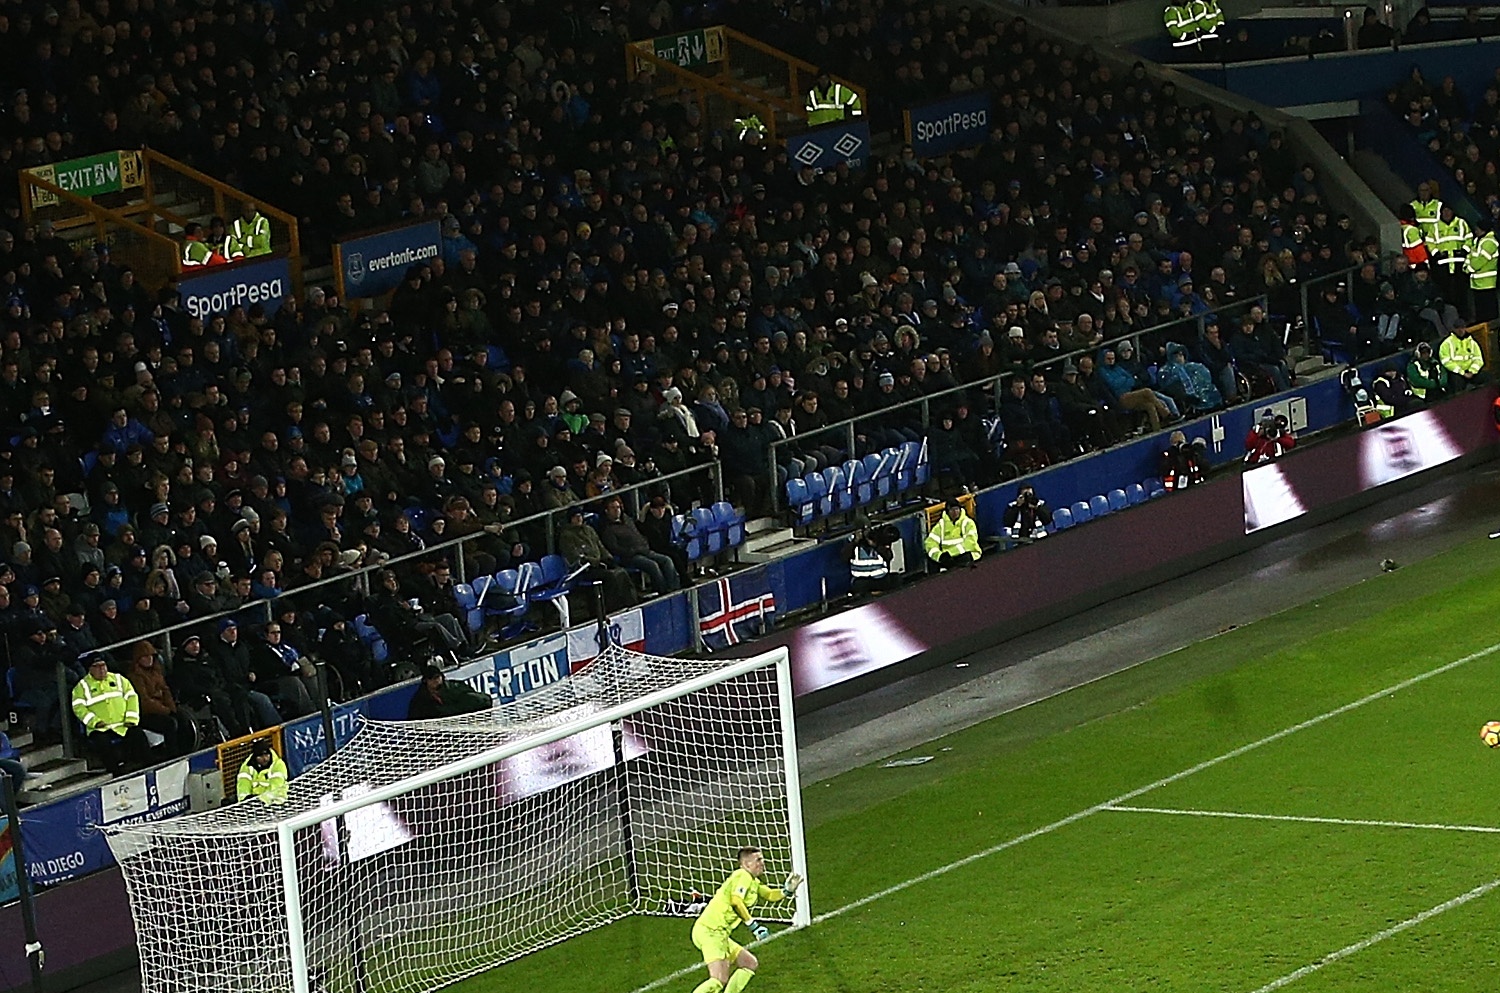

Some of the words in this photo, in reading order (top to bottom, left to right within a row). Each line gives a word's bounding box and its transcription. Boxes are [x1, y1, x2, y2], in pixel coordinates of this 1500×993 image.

[917, 110, 987, 143] SportPesa
[58, 167, 92, 191] EXIT
[369, 244, 438, 272] evertonfc.com
[187, 278, 283, 320] SportPesa
[47, 851, 85, 875] DIEGO
